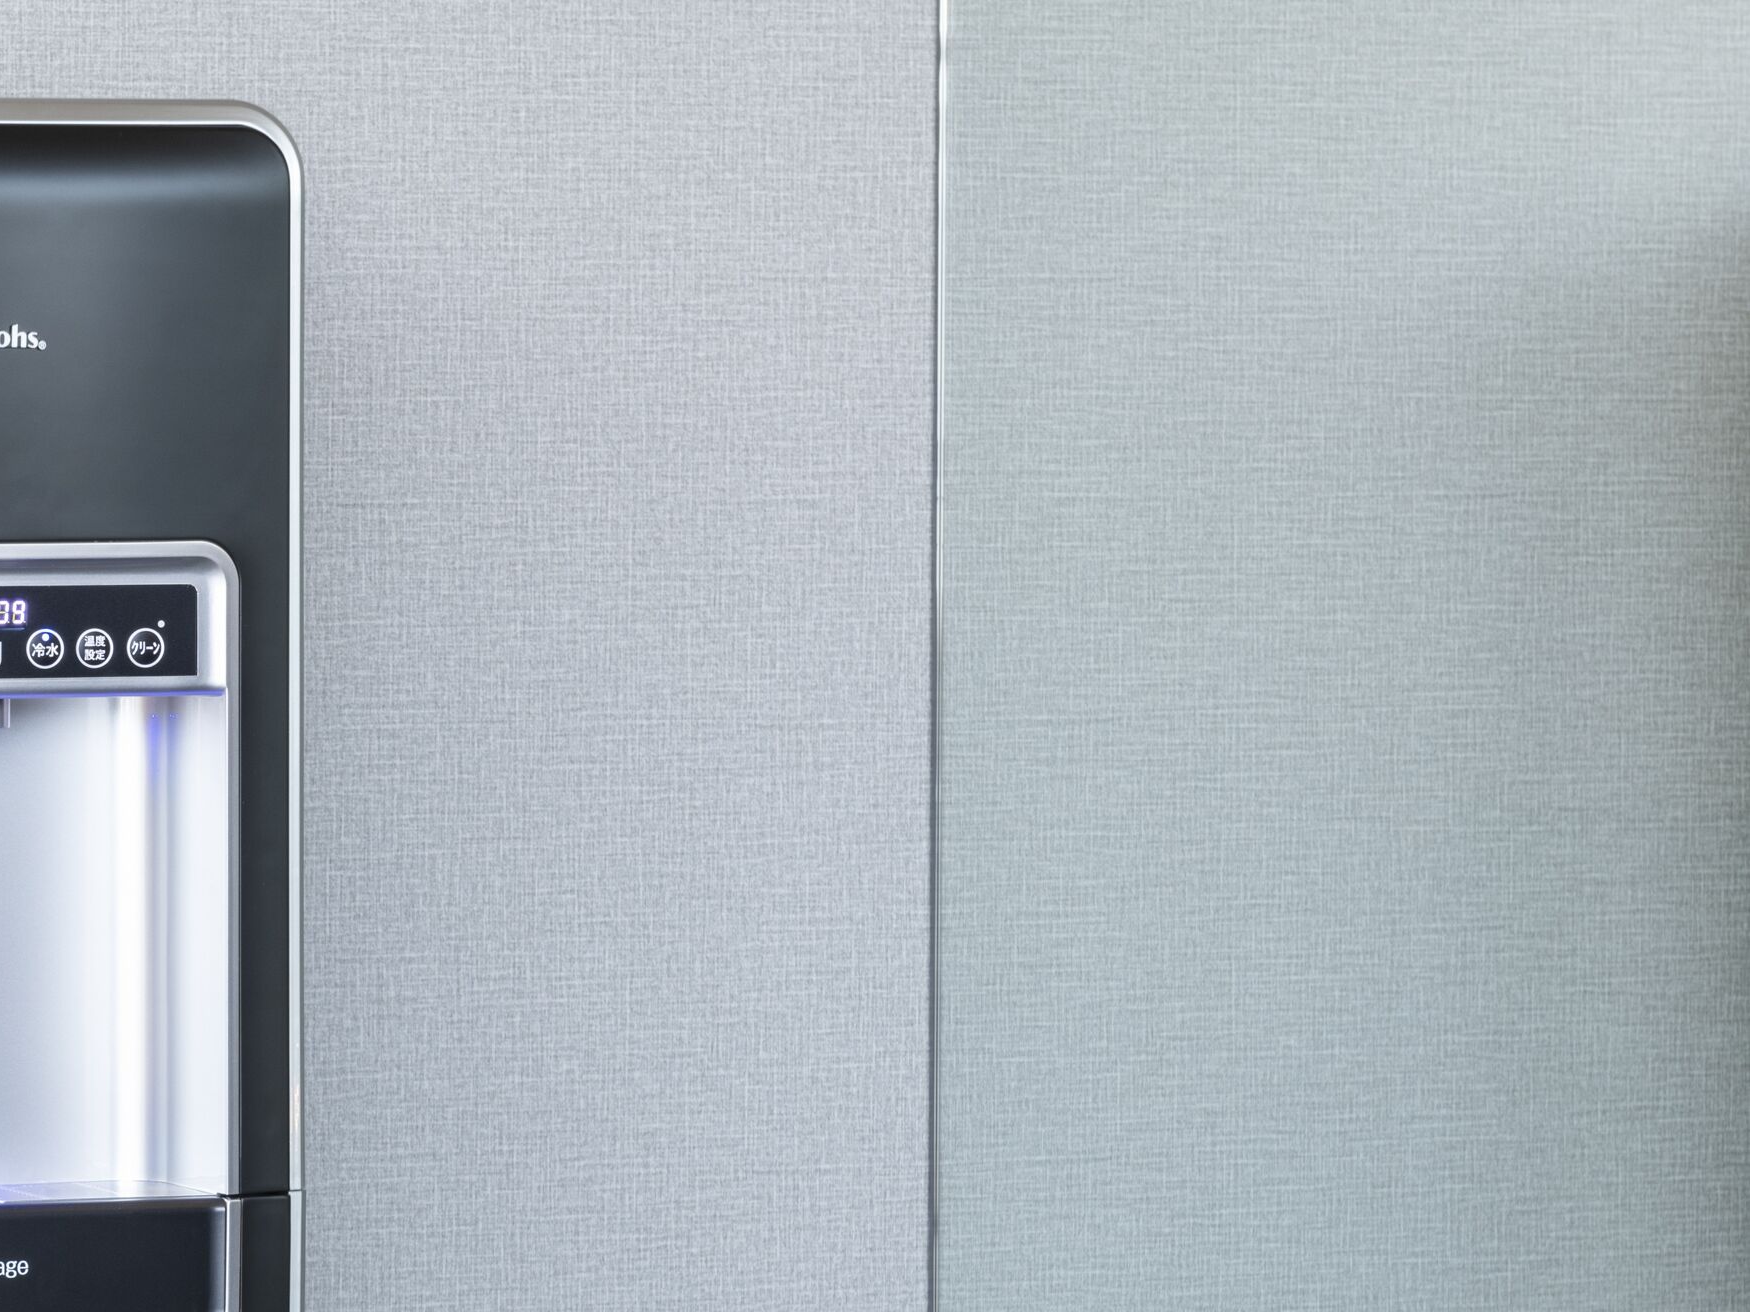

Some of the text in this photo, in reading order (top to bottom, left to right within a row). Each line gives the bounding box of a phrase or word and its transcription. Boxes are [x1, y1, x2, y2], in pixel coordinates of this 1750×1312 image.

[84, 635, 107, 647] 温度
[131, 640, 161, 655] クリーン
[31, 642, 59, 658] 冷水
[84, 649, 106, 661] 設定
